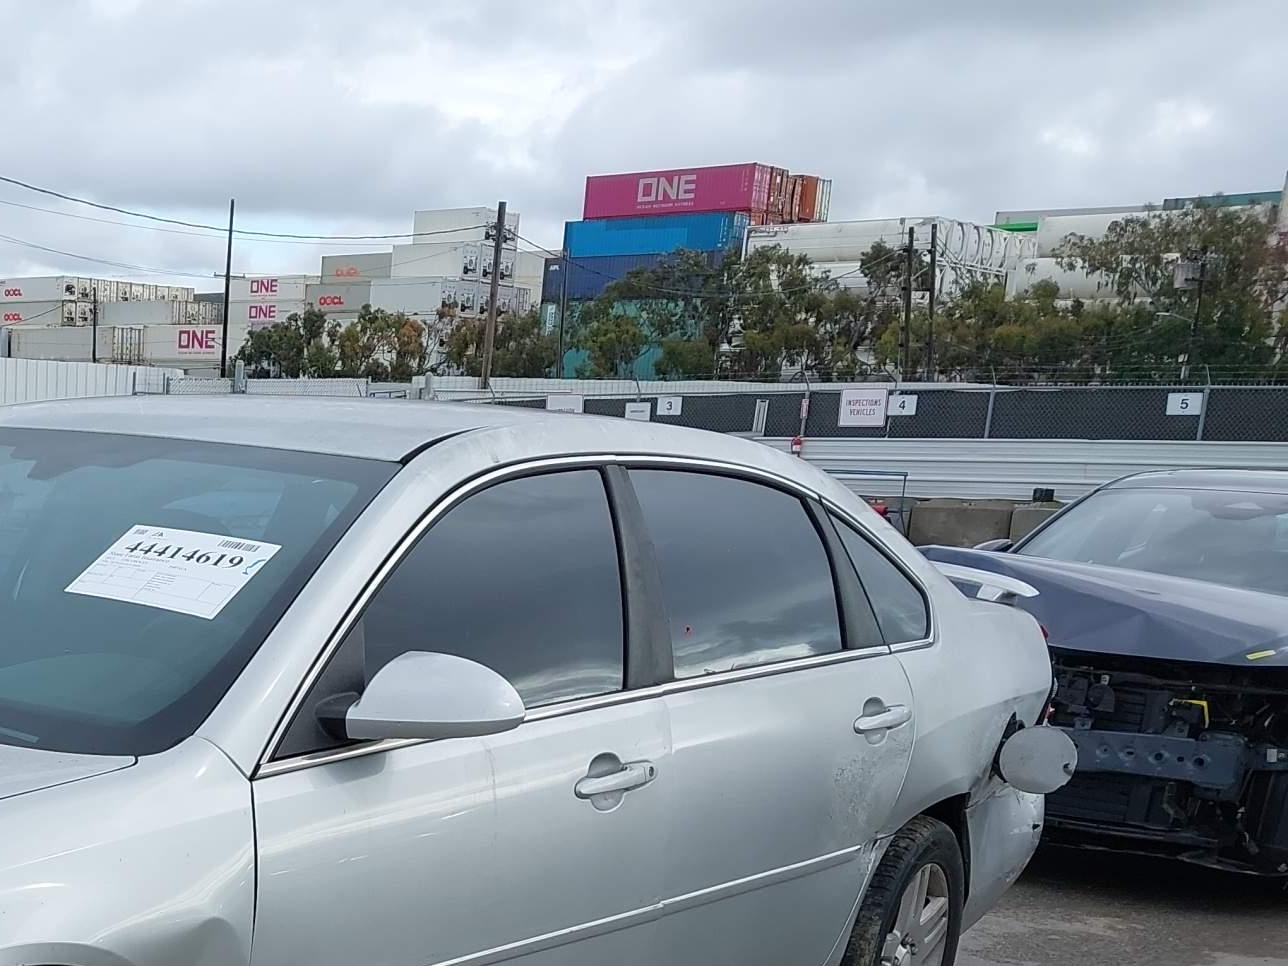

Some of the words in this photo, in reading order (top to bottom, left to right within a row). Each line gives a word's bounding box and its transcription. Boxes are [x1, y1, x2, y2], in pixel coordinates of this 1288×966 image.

[637, 174, 697, 202] ONE
[250, 279, 278, 294] ONE
[4, 288, 23, 297] OOCL
[319, 295, 344, 306] OOCL
[3, 312, 23, 321] OOCL
[248, 305, 276, 319] ONE
[178, 329, 216, 349] ONE
[666, 400, 673, 411] 3
[898, 400, 906, 410] 4
[1179, 398, 1190, 409] 5
[849, 408, 876, 416] VEHICLES
[125, 540, 244, 569] 44414619
